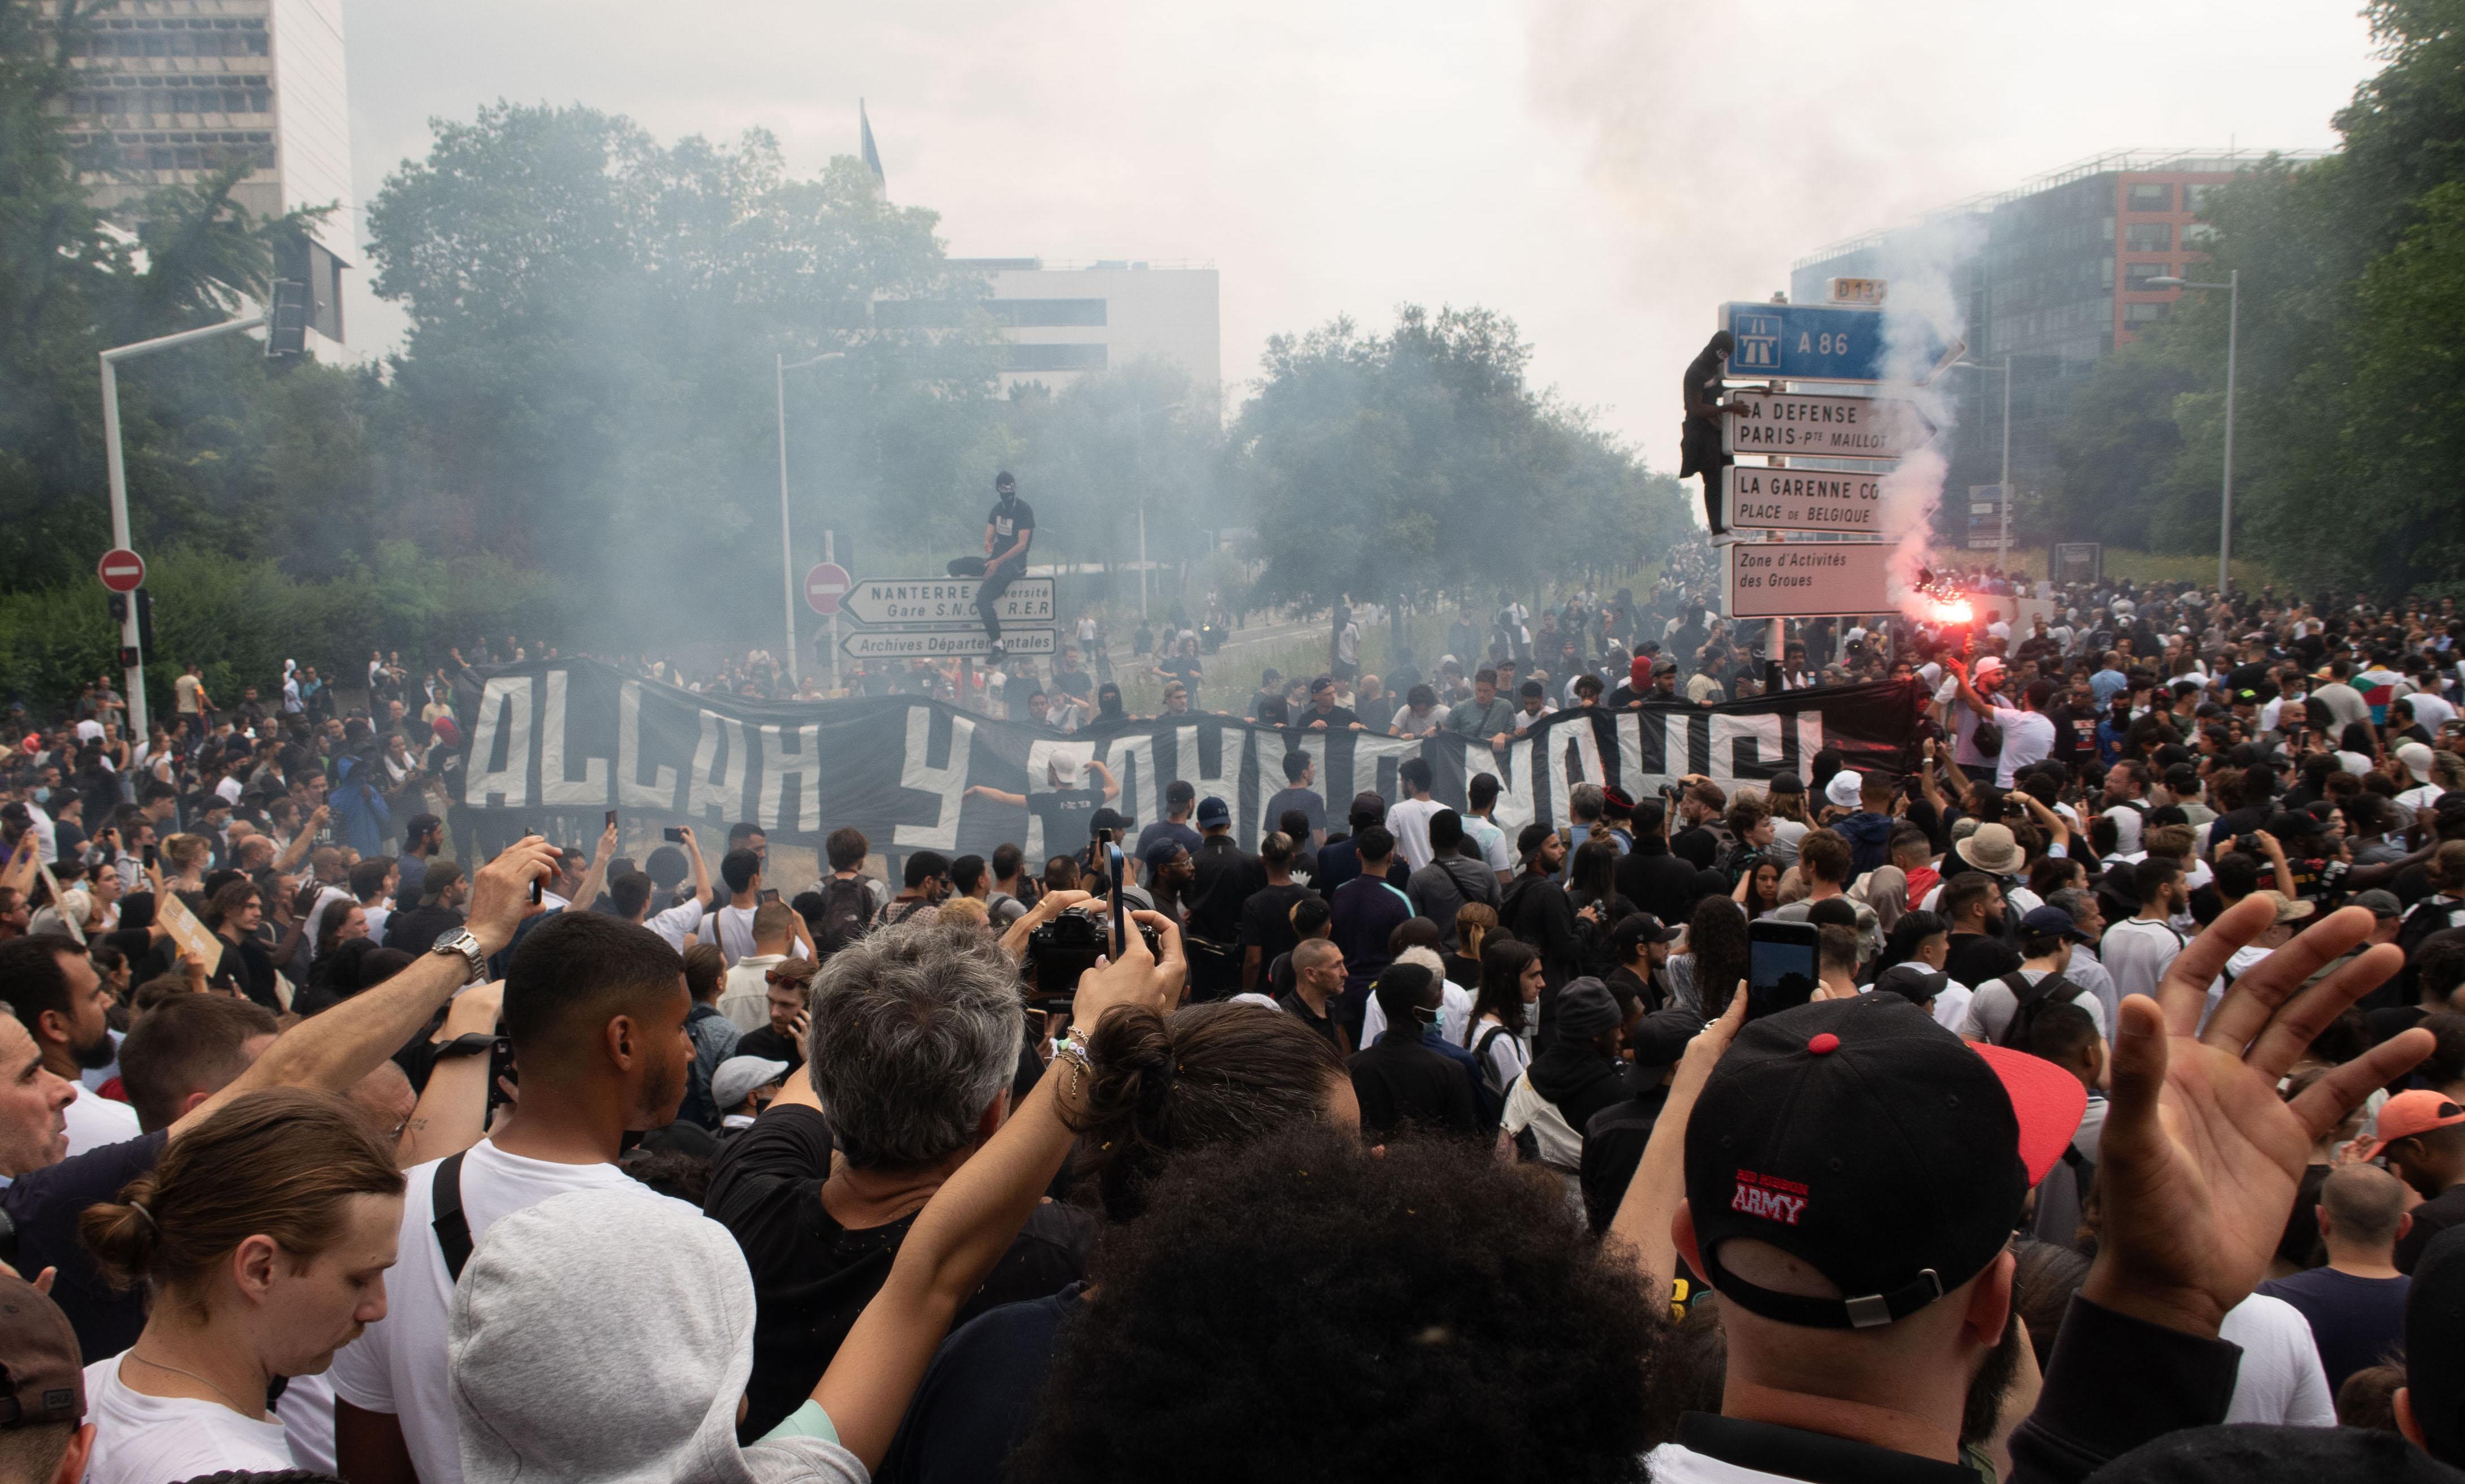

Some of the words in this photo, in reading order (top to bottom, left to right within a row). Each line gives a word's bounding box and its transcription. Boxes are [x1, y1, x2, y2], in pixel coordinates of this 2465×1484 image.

[1797, 331, 1811, 353] A
[1819, 332, 1848, 356] 86
[1774, 403, 1857, 423] DEFENSE
[1741, 477, 1760, 494] LA
[1771, 478, 1851, 499] GARENNE
[1740, 504, 1781, 519] PLACE
[1788, 510, 1799, 520] DE
[1807, 507, 1870, 523] BELGIQUE
[1740, 553, 1772, 567] Zone
[1778, 552, 1846, 566] d'Activités
[1740, 574, 1762, 587] des
[1768, 573, 1812, 587] Groues
[871, 586, 970, 600] NANTERRE
[887, 604, 925, 617] Gare
[860, 639, 923, 653] Archives
[465, 670, 820, 832] ALLAH
[893, 705, 975, 851] Y
[1732, 1183, 1807, 1225] ARMY
